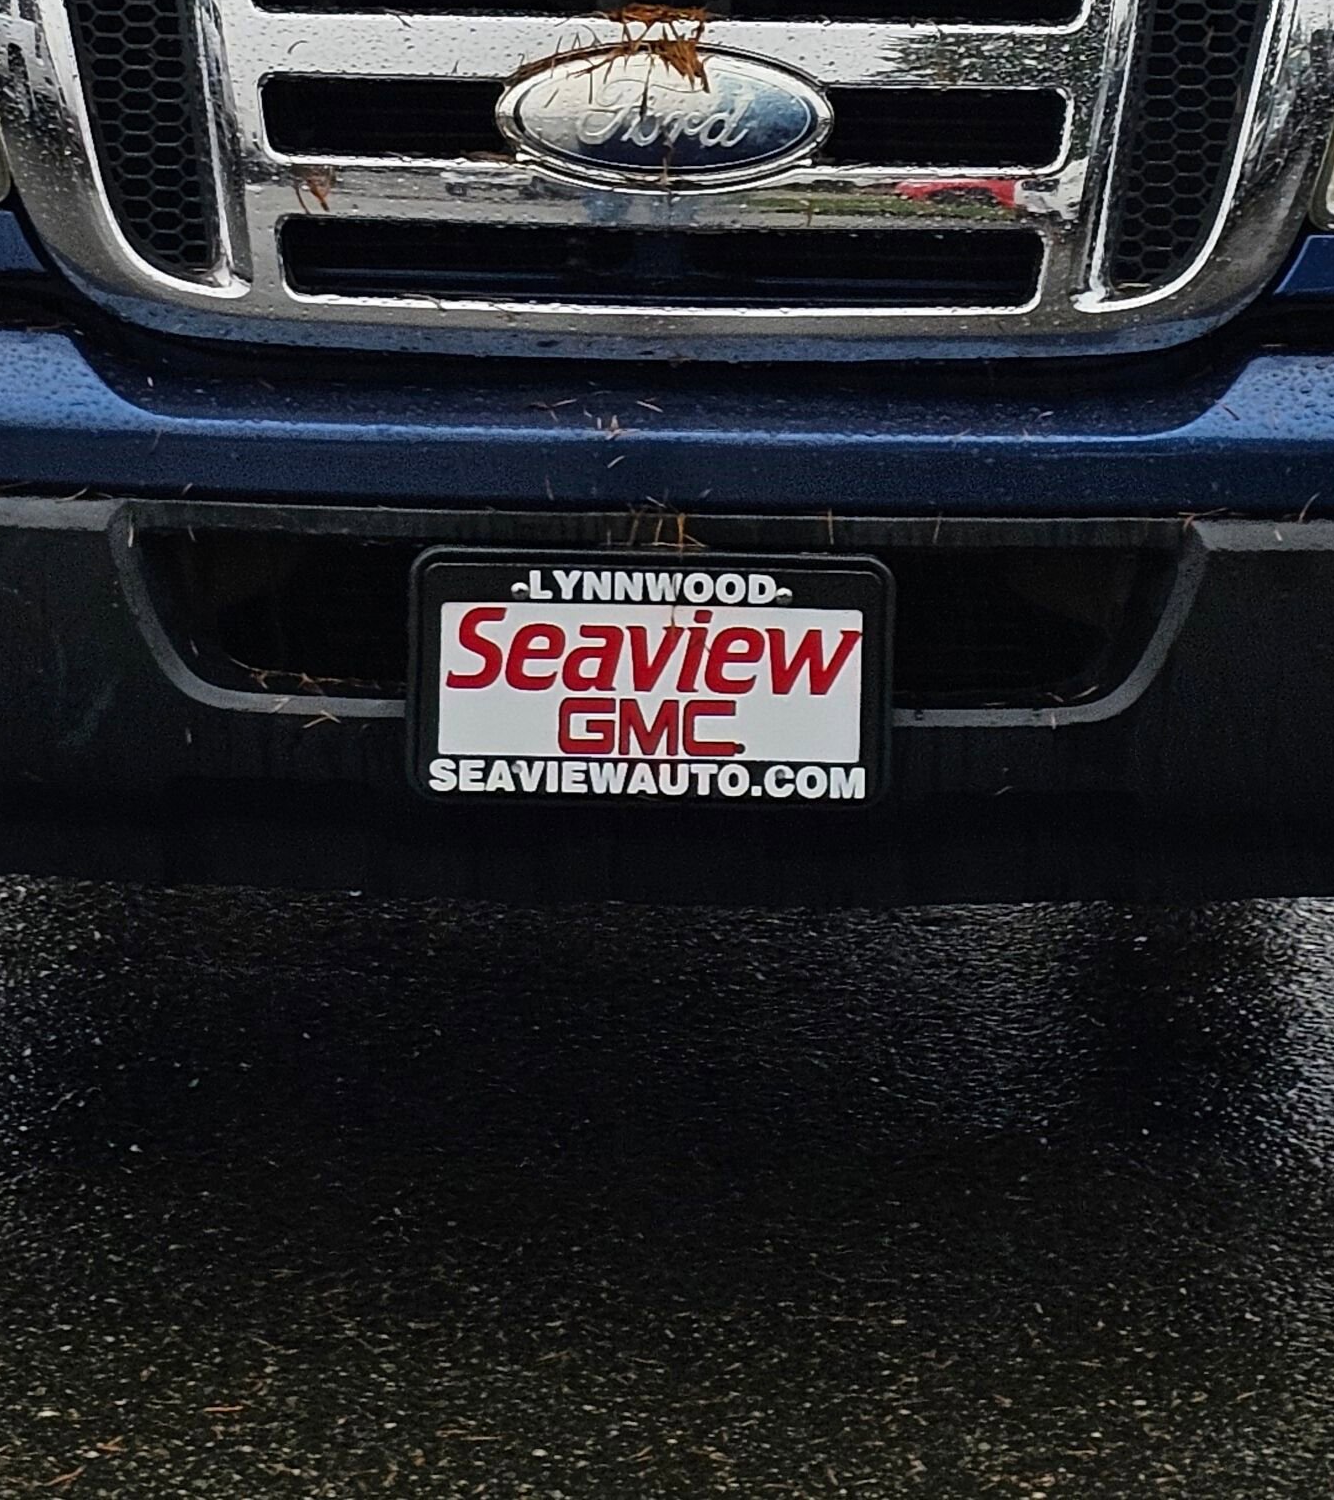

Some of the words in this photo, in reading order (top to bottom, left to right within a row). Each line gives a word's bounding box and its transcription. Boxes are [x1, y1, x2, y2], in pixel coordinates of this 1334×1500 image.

[576, 78, 755, 148] Ford
[528, 570, 777, 604] LYNNWOOD
[446, 607, 864, 695] Seaview
[558, 698, 740, 757] GMC
[428, 758, 866, 800] SEAVIEWAUTO.COM
